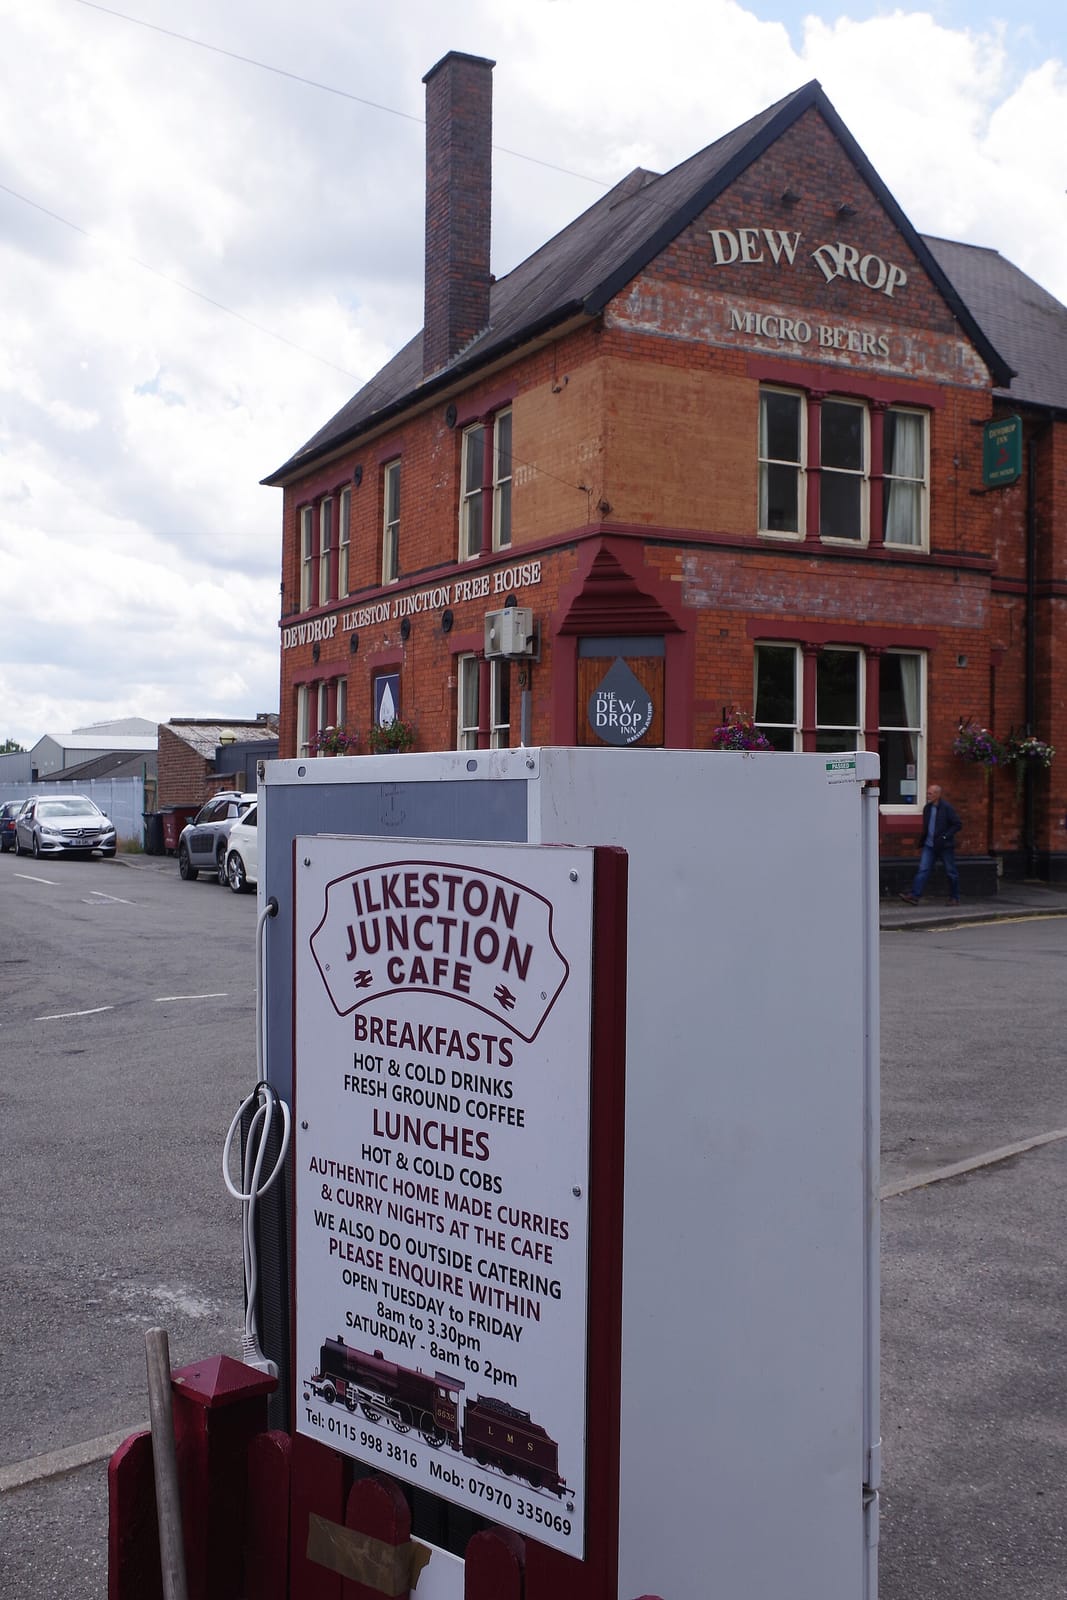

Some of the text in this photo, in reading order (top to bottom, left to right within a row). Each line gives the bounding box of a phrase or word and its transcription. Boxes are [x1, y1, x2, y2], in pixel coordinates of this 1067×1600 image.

[709, 229, 907, 297] DEW DROP
[730, 310, 890, 357] MICRO BEERS
[283, 561, 541, 650] DEWDROP ILKESTON JUNCTION FREE HOUSE
[596, 700, 635, 712] DEW
[596, 713, 641, 726] DROP
[352, 873, 520, 929] ILKESTON
[346, 915, 533, 981] JUNCTION
[387, 956, 471, 994] CAFE
[354, 1014, 513, 1067] BREAKFASTS
[344, 1074, 525, 1127] FRESH GROUND COFFEE
[354, 1053, 513, 1098] HOT & COLD DRINKS
[373, 1108, 490, 1161] LUNCHES
[362, 1144, 502, 1194] HOT & COLD COBS
[309, 1156, 569, 1240] AUTHENTIC HOME MADE CURRIES
[321, 1184, 553, 1264] & CURRY NIGHTS AT THE CAFE
[314, 1209, 562, 1300] WE ALSO DO OUTSIDE CATERING
[329, 1238, 540, 1322] PLEASE ENQUIRE WITHIN
[342, 1269, 523, 1342] OPEN TUESDAY to FRIDAY
[377, 1302, 480, 1351] 8am to 3.30pm
[346, 1311, 416, 1350] SATURDAY
[430, 1342, 460, 1367] 8am
[464, 1354, 479, 1373] to
[484, 1361, 518, 1388] 2pm
[306, 1408, 572, 1536] Tel: 0115 998 3816 Mob: 07970 335069
